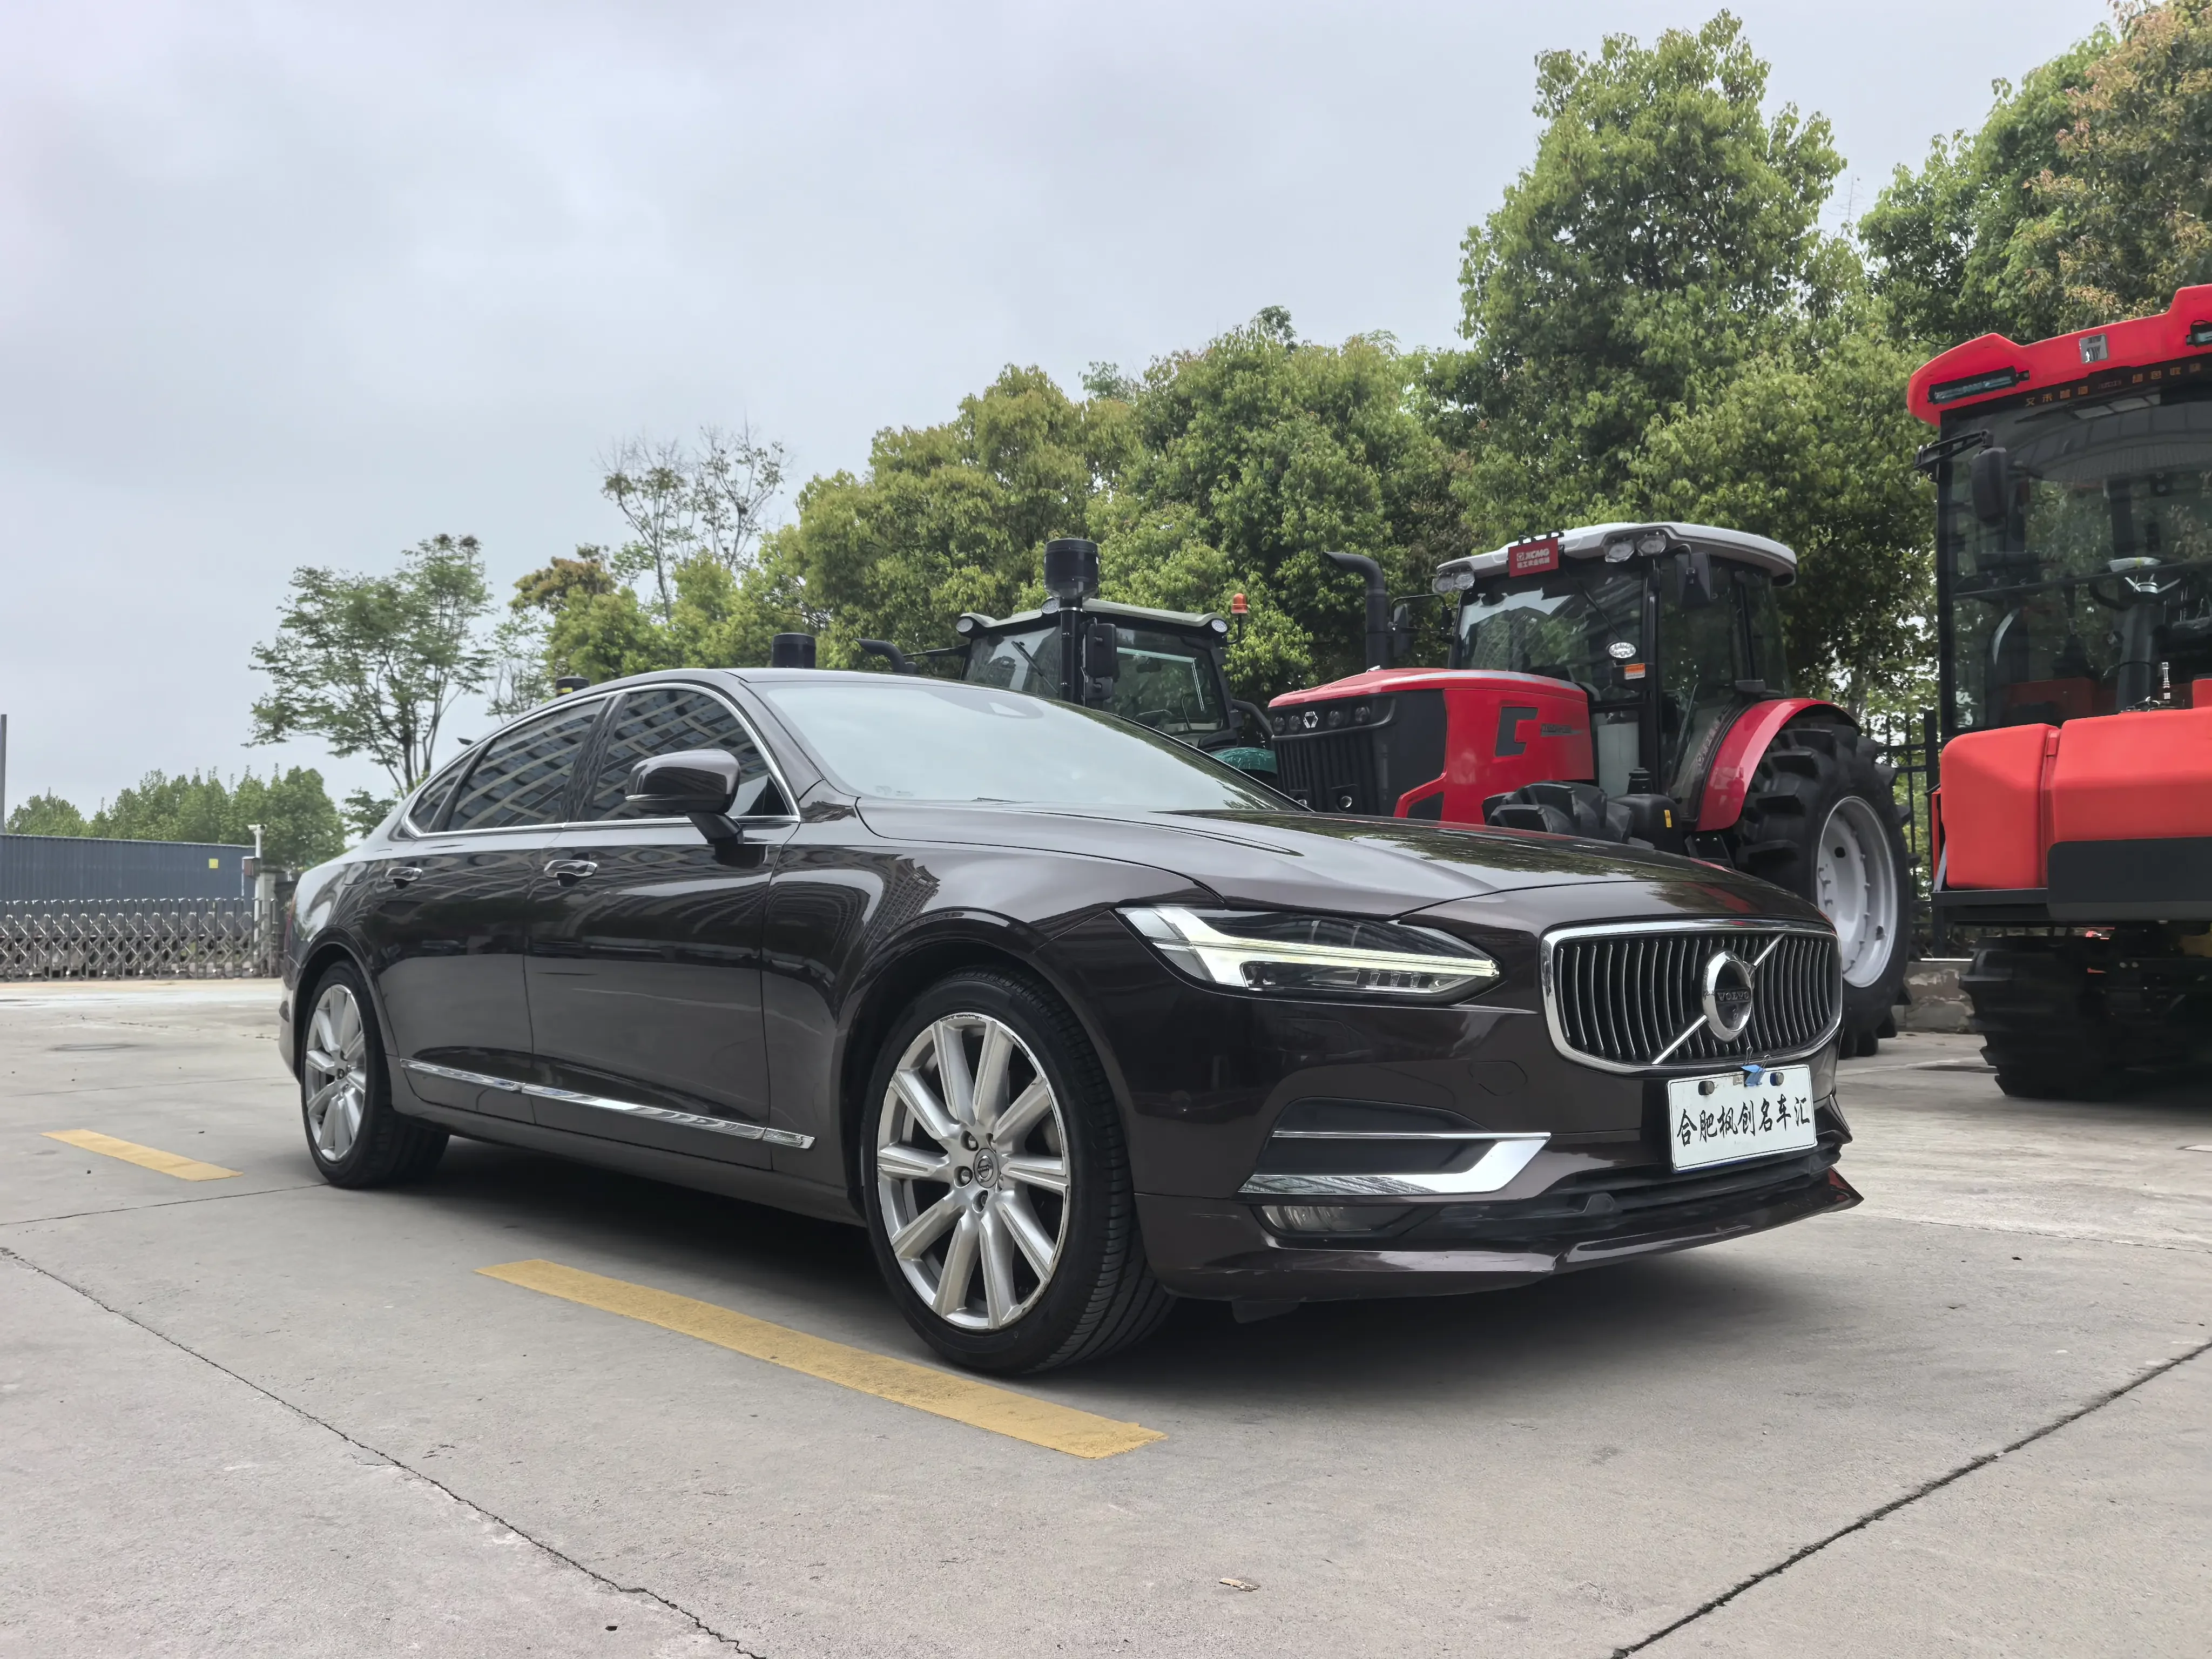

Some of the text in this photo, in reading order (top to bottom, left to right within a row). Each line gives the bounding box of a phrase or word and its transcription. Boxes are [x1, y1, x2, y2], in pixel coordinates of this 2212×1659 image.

[1717, 991, 1749, 1001] VOLVO
[1677, 1094, 1810, 1147] 合肥枫创名车汇
